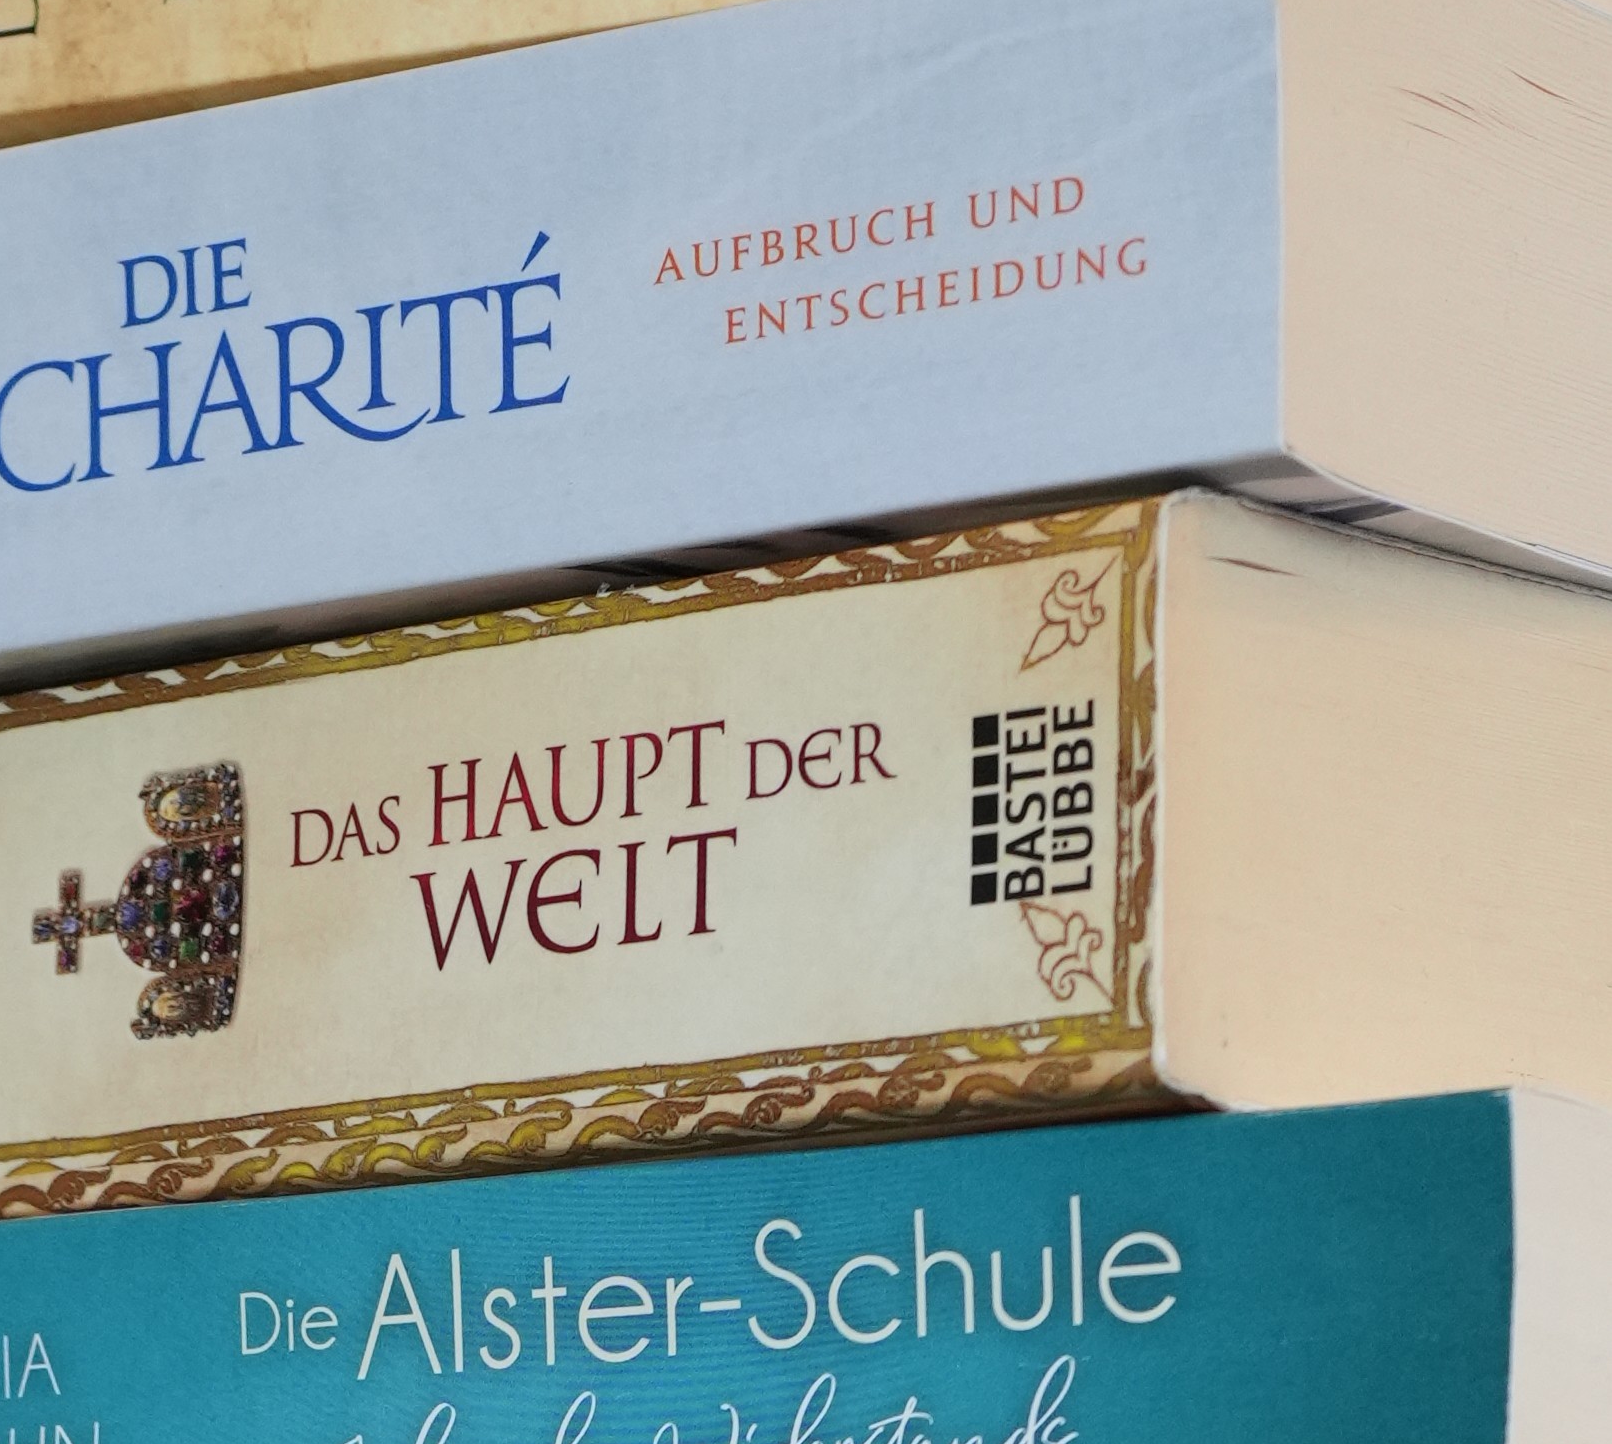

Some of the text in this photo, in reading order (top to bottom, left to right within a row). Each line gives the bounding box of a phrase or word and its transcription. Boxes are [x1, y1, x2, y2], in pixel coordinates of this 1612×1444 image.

[116, 237, 253, 329] DIE
[652, 176, 1085, 286] AUFBRUCH UND
[724, 237, 1149, 345] ENTSCHEIDUNG
[288, 718, 899, 868] DAS HAUPT DER
[1003, 705, 1048, 902] BASTEI
[1050, 698, 1095, 896] LÜBBE
[408, 827, 739, 972] WELT
[238, 1194, 1184, 1382] Die Alster-Schule
